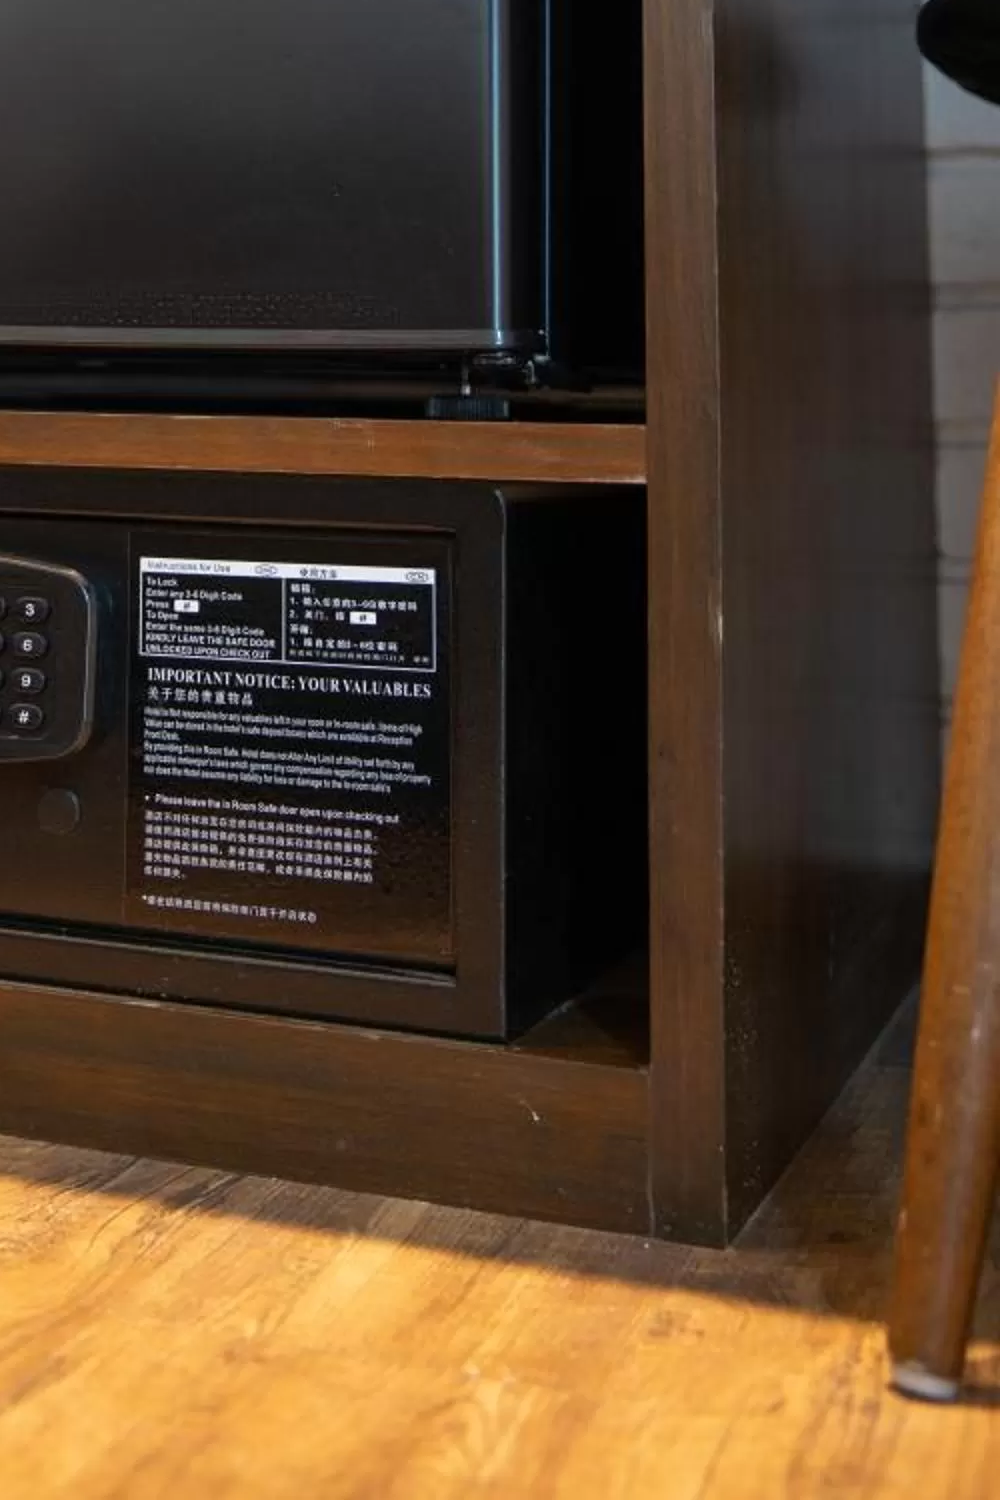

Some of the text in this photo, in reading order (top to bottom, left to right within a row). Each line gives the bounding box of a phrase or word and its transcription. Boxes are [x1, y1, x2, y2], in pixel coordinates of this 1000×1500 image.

[213, 563, 231, 573] Use
[25, 603, 35, 617] 3
[146, 609, 156, 619] To
[23, 639, 33, 652] 6
[249, 638, 276, 647] DOOR
[21, 674, 31, 687] 9
[147, 667, 431, 698] IMPORTANT NOTICE: YOUR VALUABLES
[19, 709, 29, 723] #
[232, 799, 256, 811] Room
[257, 802, 277, 813] Safe
